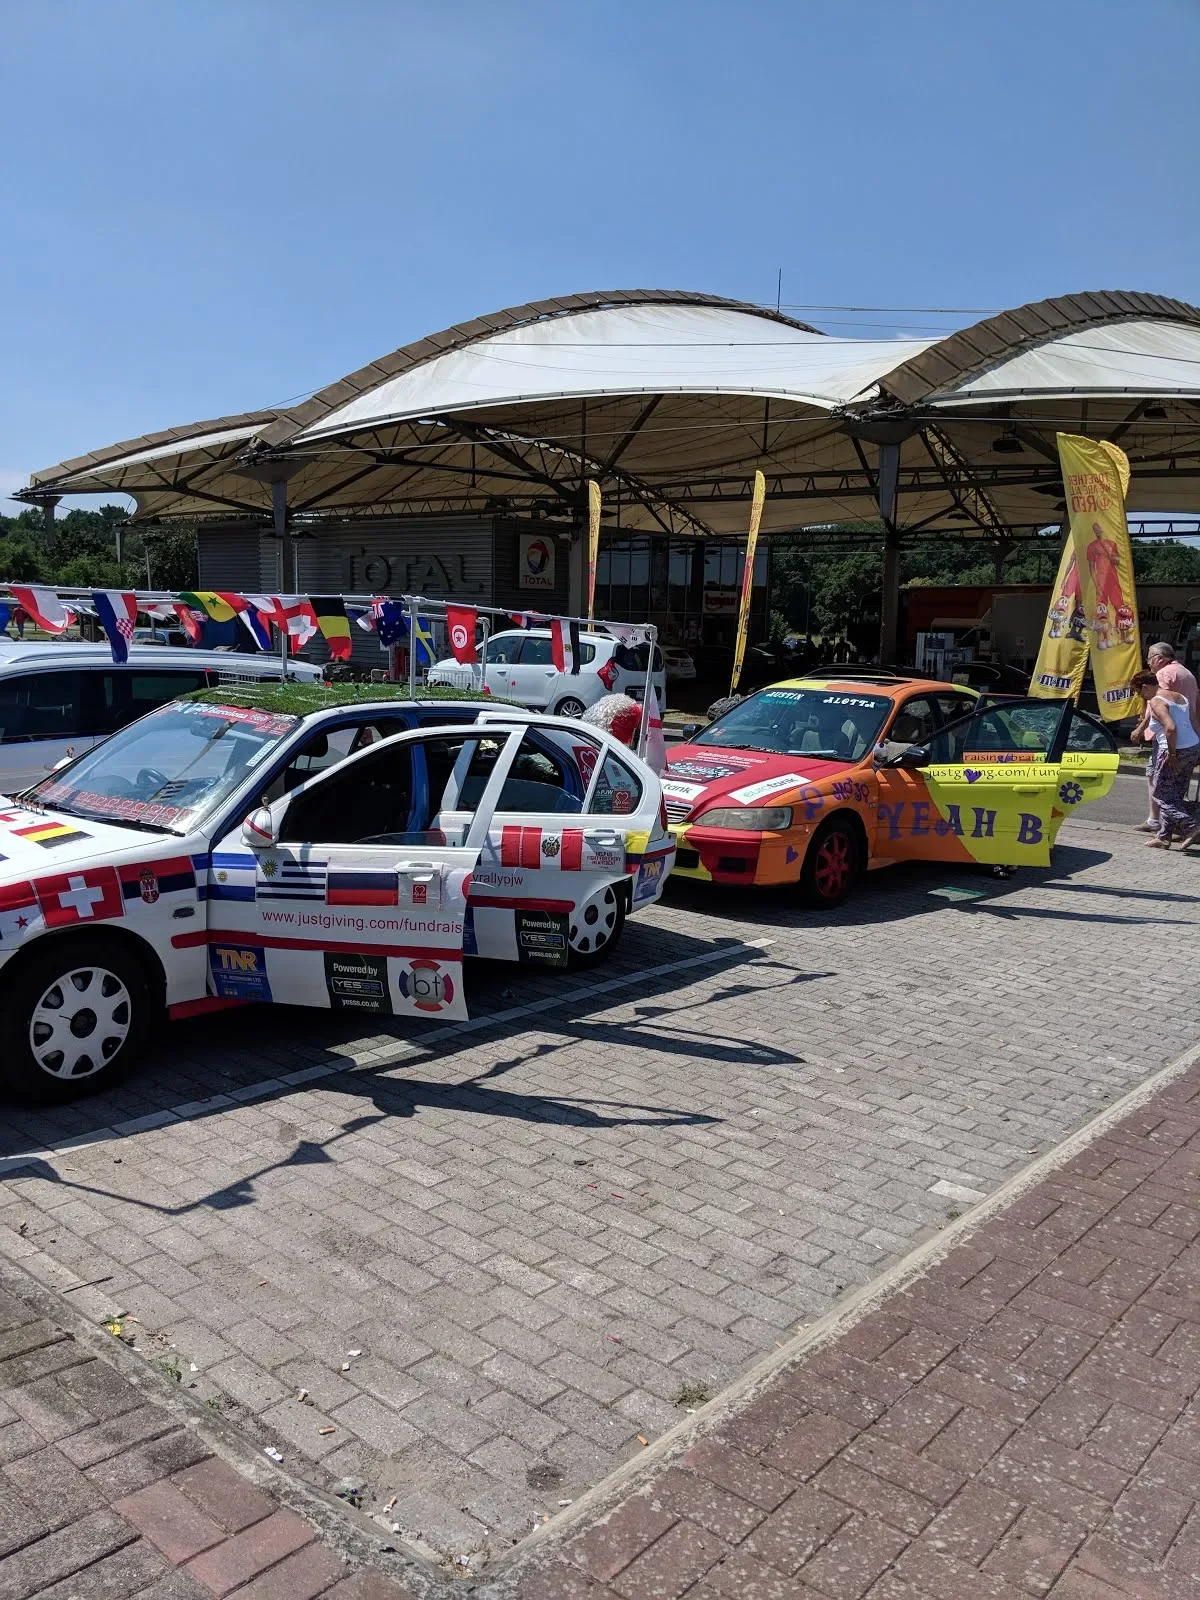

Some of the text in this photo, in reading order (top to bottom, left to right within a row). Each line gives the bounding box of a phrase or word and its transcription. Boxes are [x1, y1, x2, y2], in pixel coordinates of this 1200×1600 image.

[332, 547, 483, 593] TOTAL
[523, 575, 553, 587] TOTAL
[743, 775, 801, 798] eurotank
[262, 910, 463, 934] www.justgiving.com/fundrais
[522, 918, 561, 932] Powered by
[523, 933, 561, 943] YESSS
[216, 948, 258, 972] TNR
[528, 951, 561, 961] yesss.co.uk
[333, 962, 378, 977] Powered by
[335, 979, 381, 991] YESSS
[413, 976, 441, 998] bt
[341, 998, 380, 1008] yesss.co.uk
